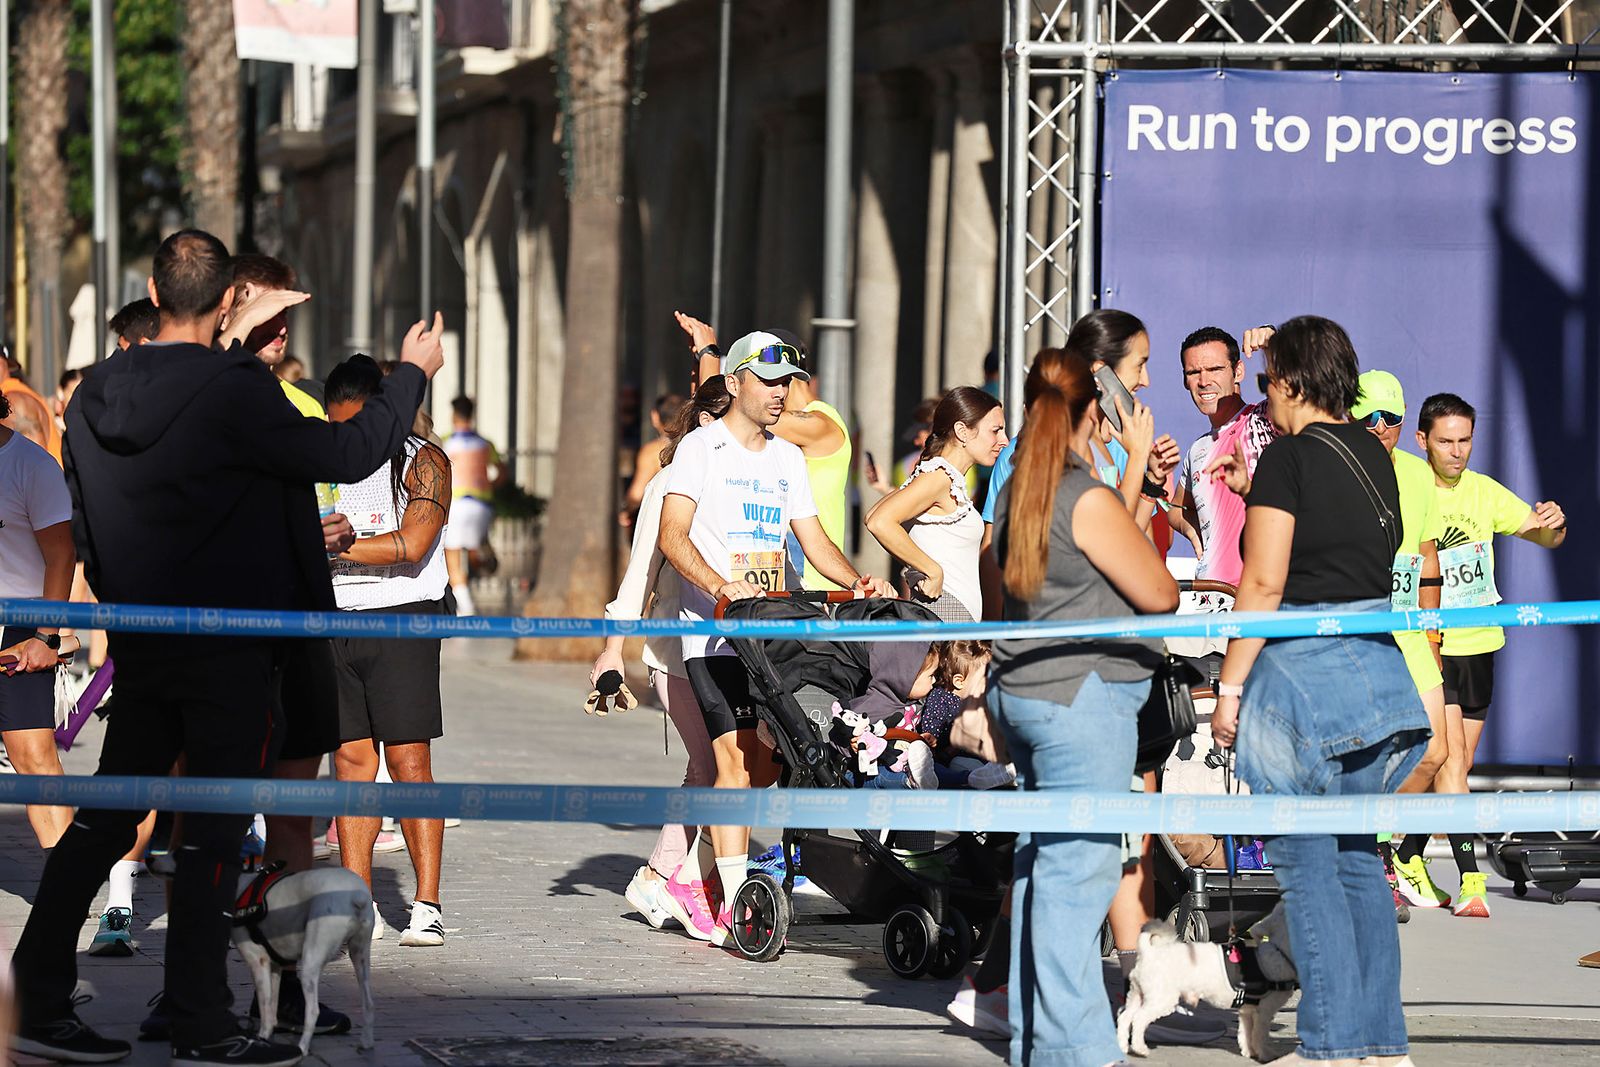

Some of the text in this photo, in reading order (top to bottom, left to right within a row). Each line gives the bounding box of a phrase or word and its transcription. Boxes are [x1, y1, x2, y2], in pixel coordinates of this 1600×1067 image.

[1127, 105, 1577, 166] Run to progress
[744, 570, 779, 591] 997
[1444, 560, 1484, 588] 564
[12, 614, 68, 625] HUELVA
[119, 615, 175, 627] HUELVA
[227, 618, 282, 629] HUELVA
[331, 619, 386, 630] HUELVA
[436, 618, 491, 630] HUELVA
[539, 619, 592, 630] HUELVA
